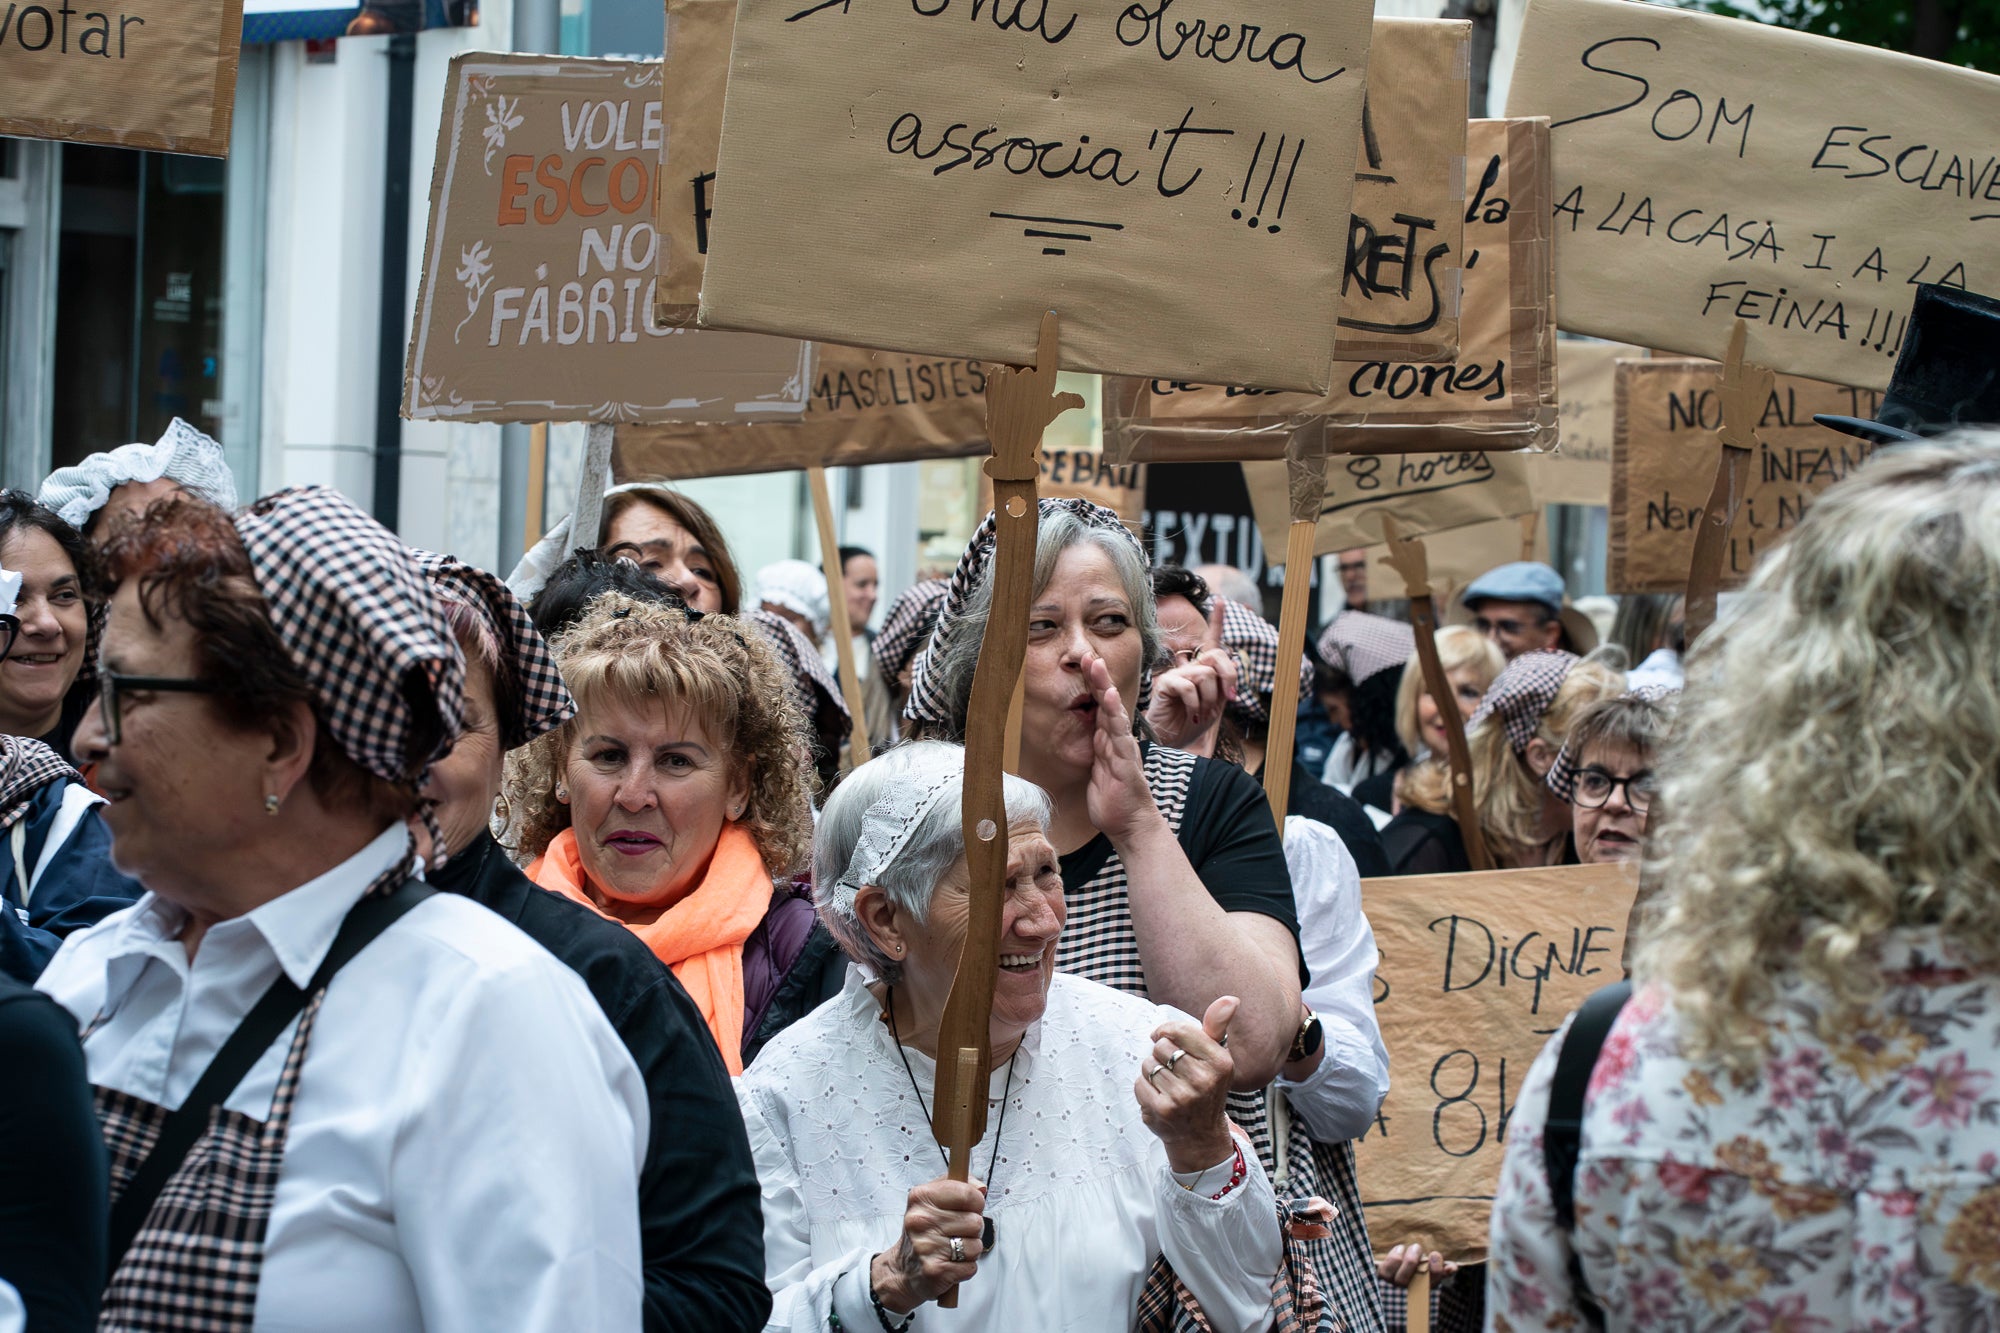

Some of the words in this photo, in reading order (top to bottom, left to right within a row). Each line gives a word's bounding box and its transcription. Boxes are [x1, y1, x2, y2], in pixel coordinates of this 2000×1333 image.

[1116, 0, 1346, 83] obrera
[1550, 37, 1754, 159] SOM
[498, 154, 659, 226] ESCO
[1553, 186, 1585, 232] A
[1596, 192, 1656, 237] LA
[1852, 247, 1889, 283] A
[1907, 255, 1967, 290] LA
[1346, 456, 1381, 490] 8
